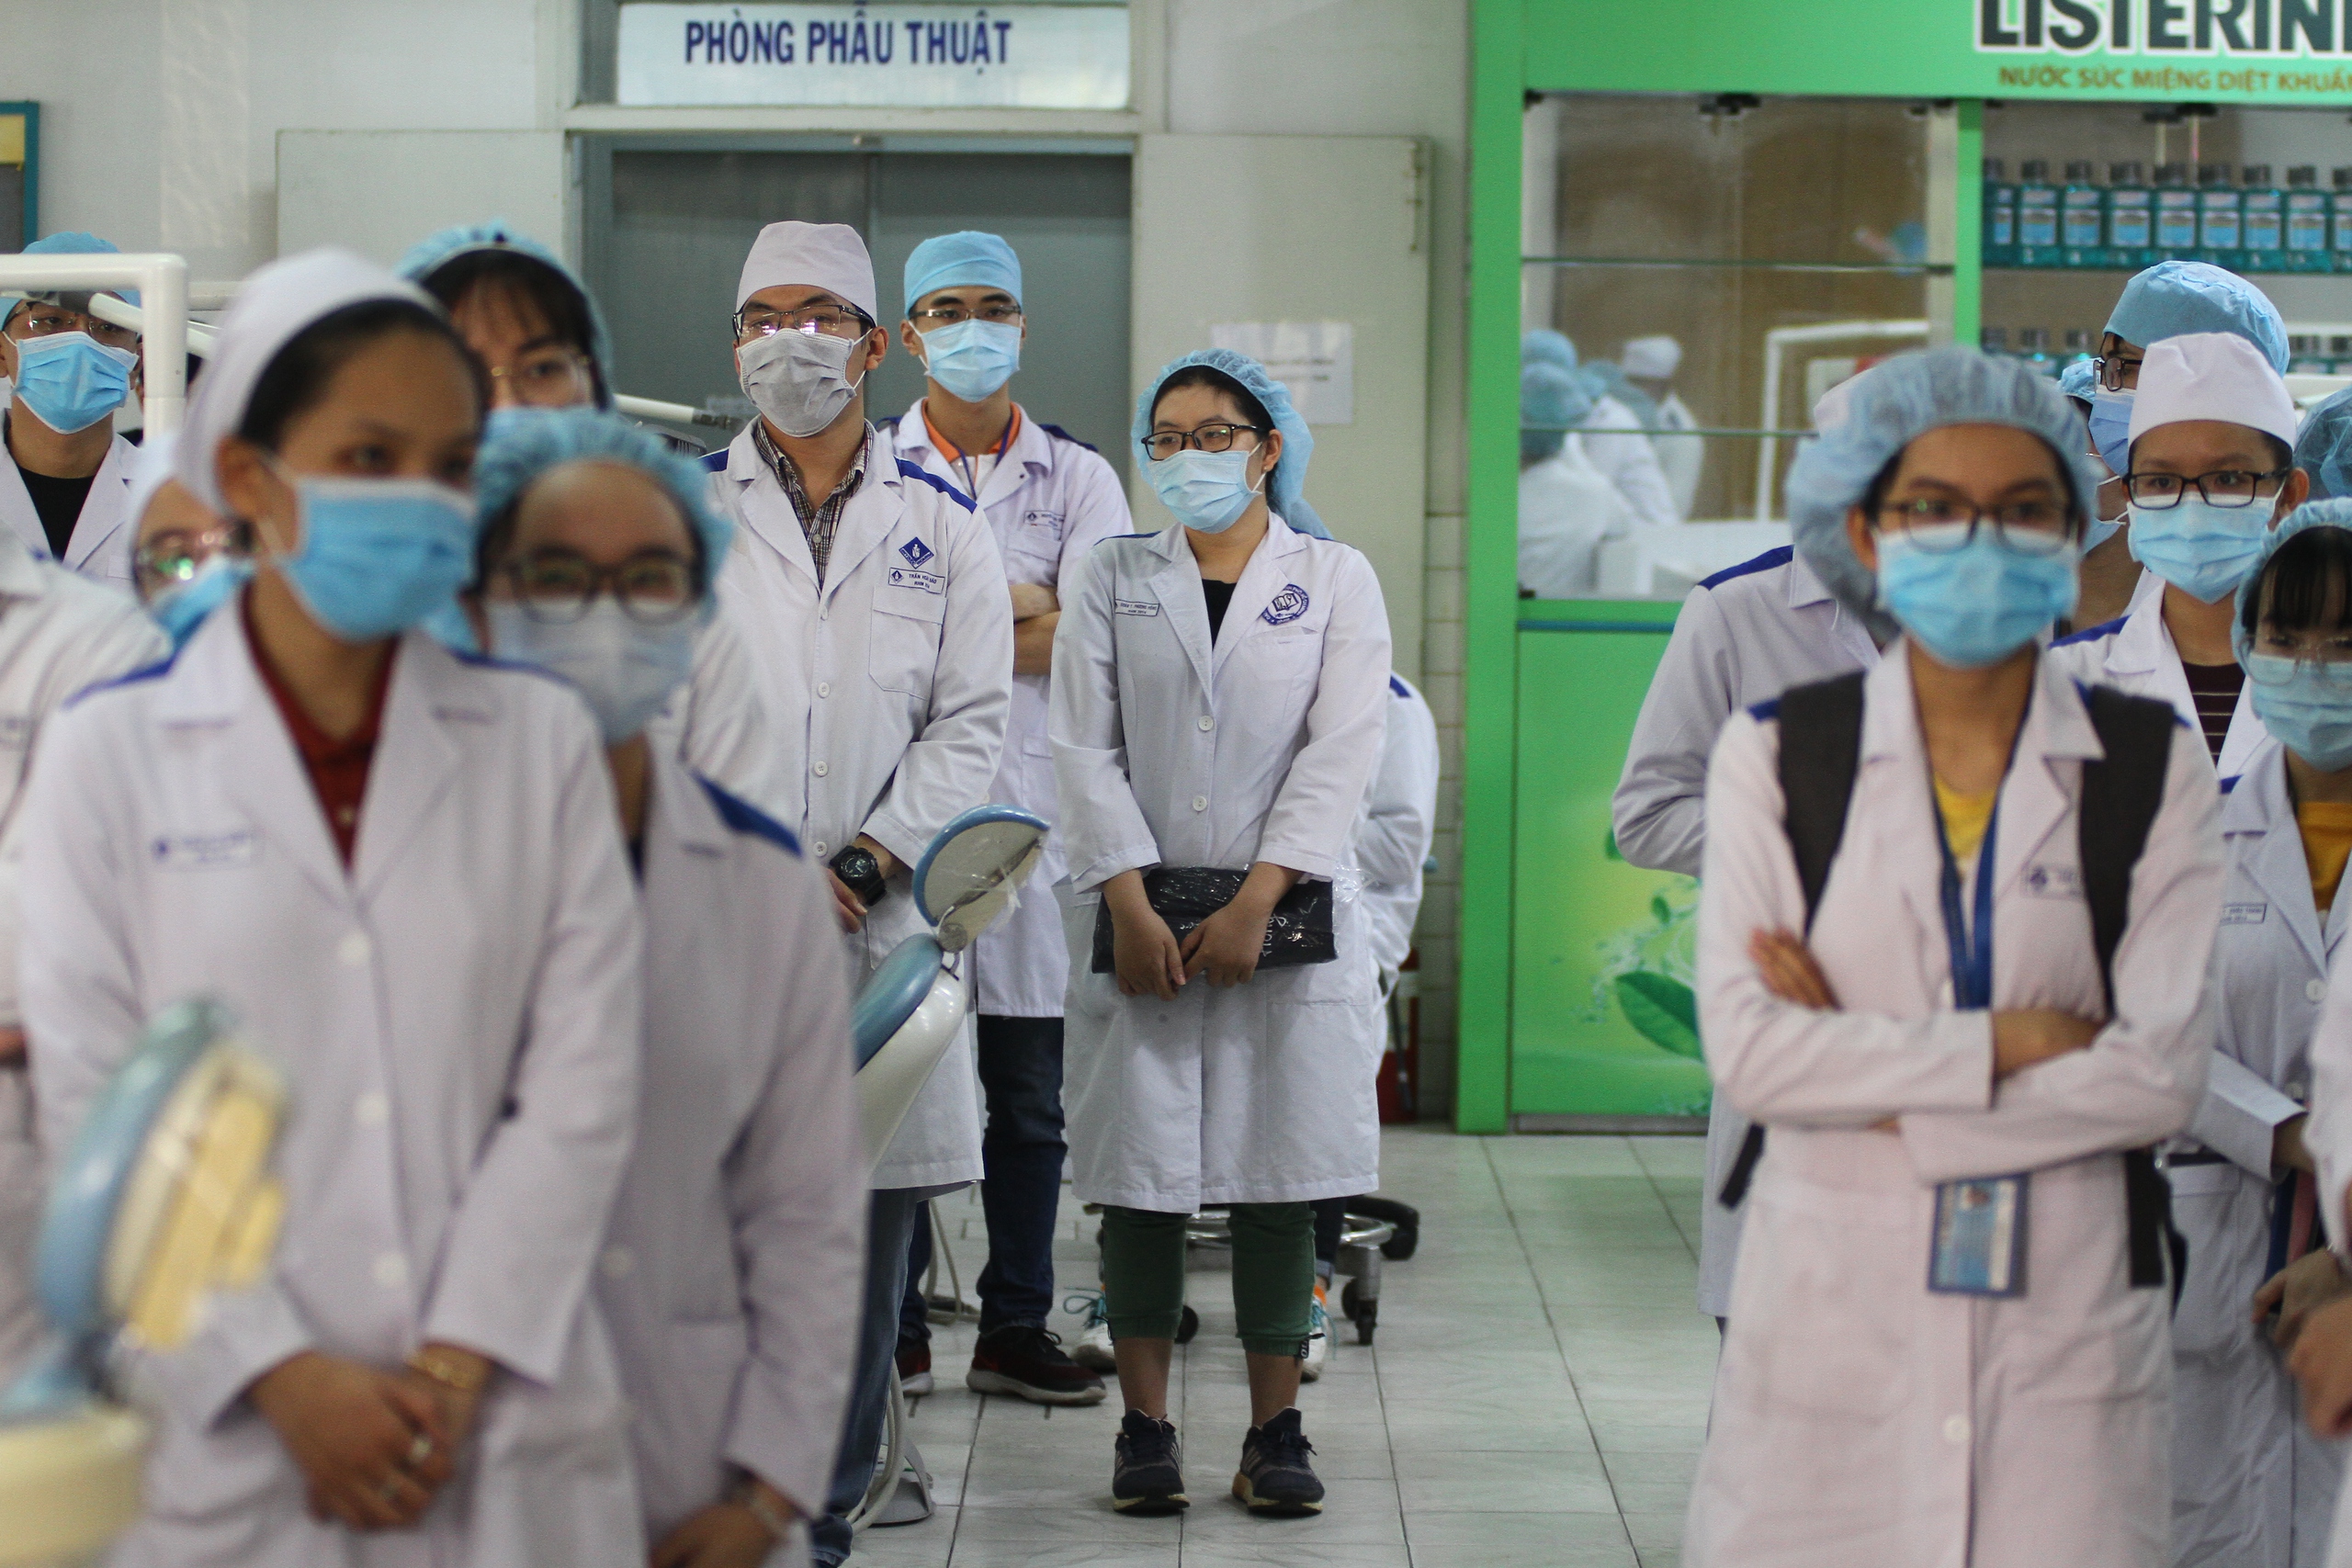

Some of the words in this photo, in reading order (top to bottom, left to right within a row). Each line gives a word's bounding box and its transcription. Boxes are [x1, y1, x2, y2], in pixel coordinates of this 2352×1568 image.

[684, 10, 795, 64] PHÒNG
[905, 10, 1012, 73] THUẬT
[1981, 0, 2352, 51] LISTERIN
[2078, 65, 2125, 88] SÚC
[2132, 67, 2211, 93] MIỆNG
[2217, 68, 2270, 93] DIỆT
